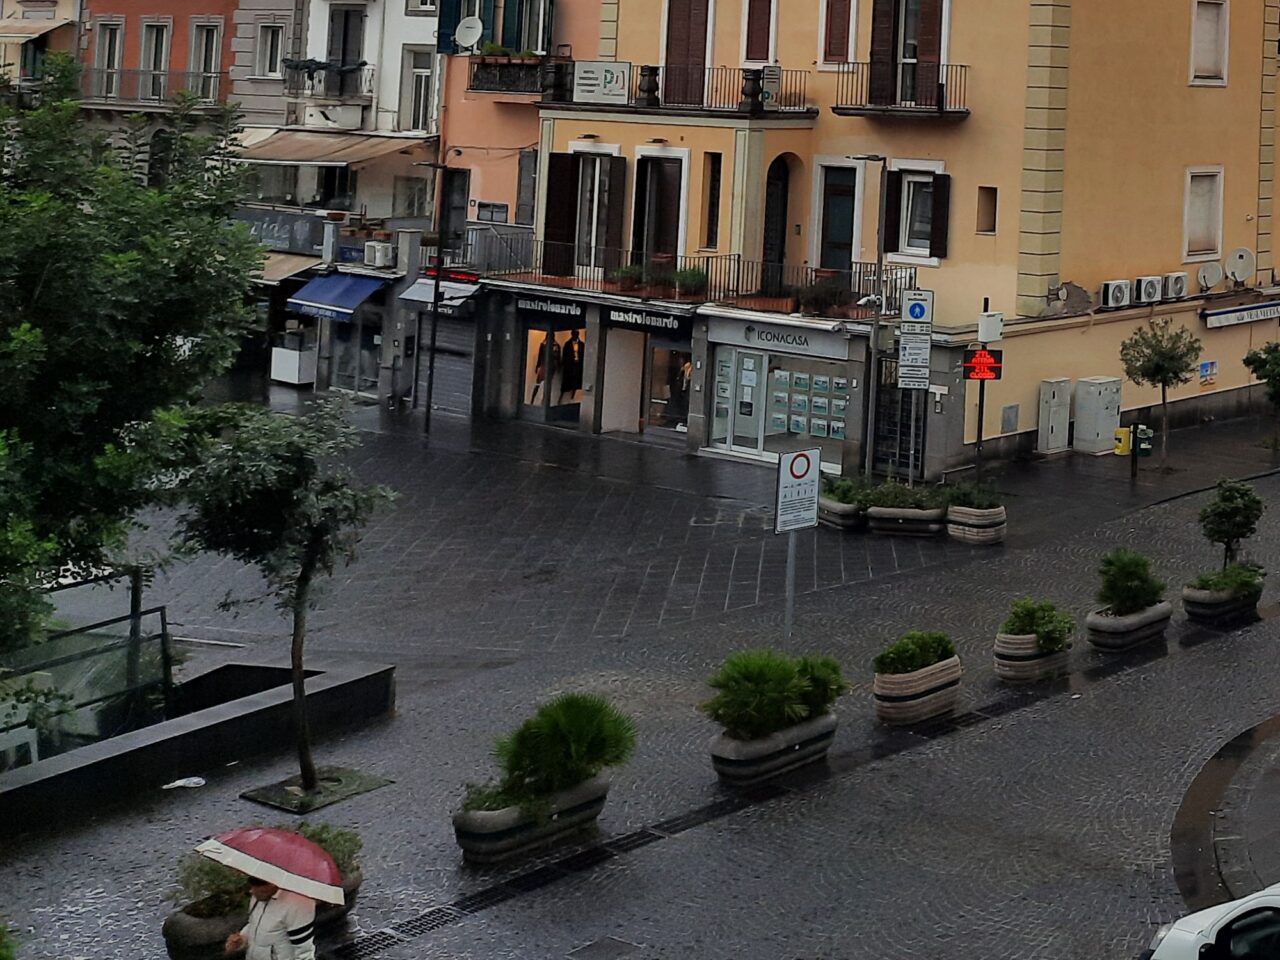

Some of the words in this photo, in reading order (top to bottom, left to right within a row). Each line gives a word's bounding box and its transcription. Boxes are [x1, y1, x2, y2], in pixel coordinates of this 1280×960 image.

[518, 298, 581, 315] mastrolonardo
[610, 309, 679, 329] mastrolonardo
[757, 329, 809, 347] ICONACASA
